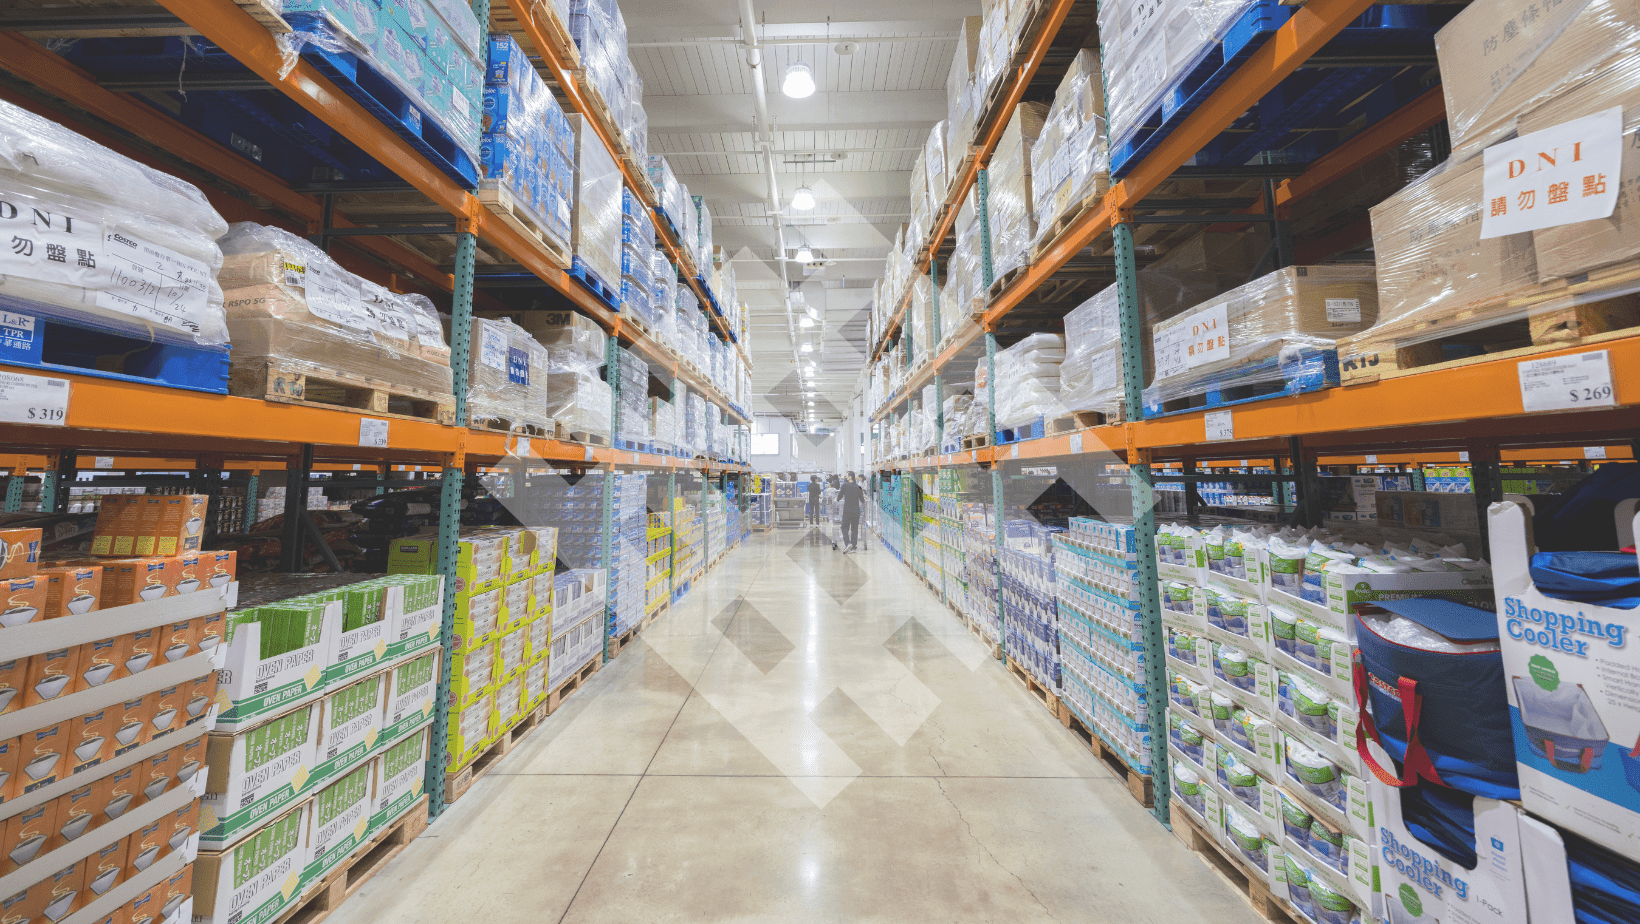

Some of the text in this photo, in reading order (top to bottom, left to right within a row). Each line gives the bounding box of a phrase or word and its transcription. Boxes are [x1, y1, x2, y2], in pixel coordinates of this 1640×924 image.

[1507, 141, 1583, 179] DNI
[1490, 173, 1606, 217] 請勿盤點
[11, 235, 96, 269] 勿盤點
[114, 233, 138, 249] COSTCO
[228, 298, 251, 308] RSPO
[546, 313, 571, 325] 3M
[3, 327, 24, 339] TPR
[1504, 596, 1626, 648] Shopping
[1506, 618, 1588, 657] Cooler
[256, 658, 283, 680] OVEN
[285, 649, 314, 670] PAPER
[263, 684, 303, 707] OVEN PAPER
[242, 751, 301, 792] OVEN PAPER
[250, 789, 290, 819] OVEN PAPER
[1380, 826, 1469, 899] Shopping
[1382, 845, 1442, 898] Cooler
[229, 857, 291, 913] OVEN PAPER
[259, 899, 280, 921] PAPER
[1476, 894, 1504, 918] 1-Pack
